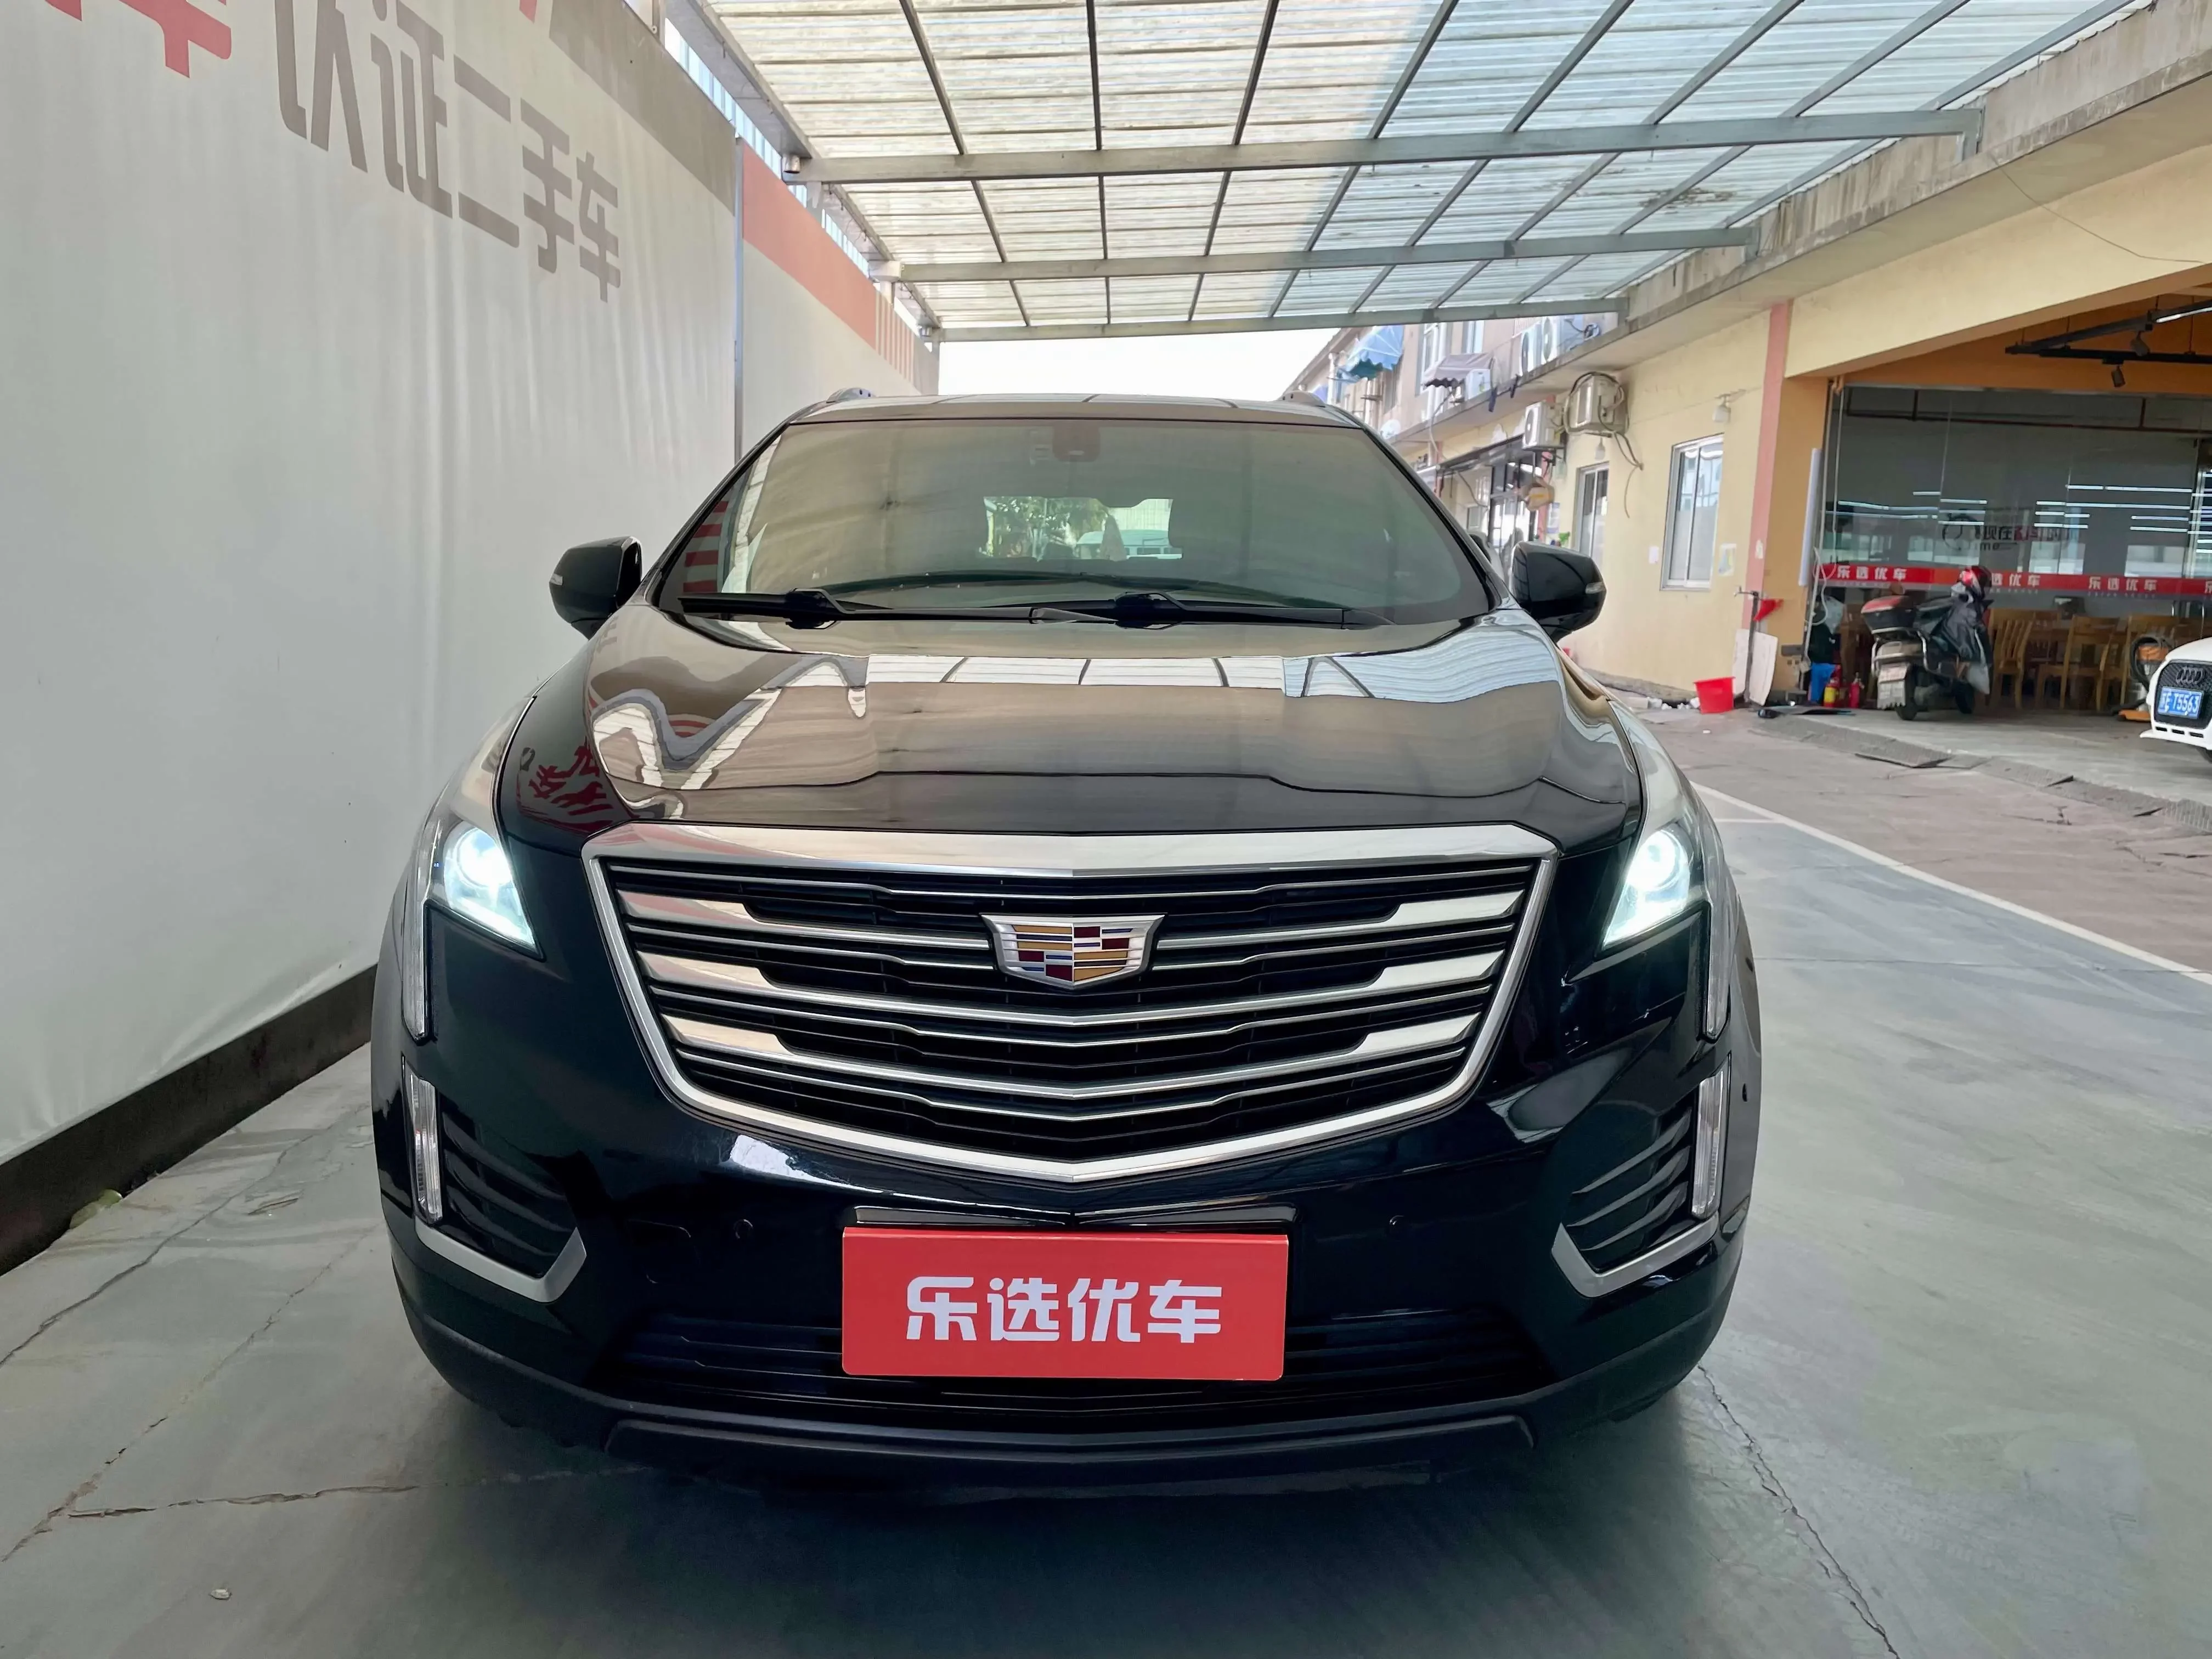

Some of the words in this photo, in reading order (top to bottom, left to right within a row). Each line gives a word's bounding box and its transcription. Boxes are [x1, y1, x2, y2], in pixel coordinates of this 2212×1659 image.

[275, 0, 620, 303] 认证二手车
[1837, 565, 1907, 581] 乐选优车
[1991, 573, 2041, 586] 选优车
[2088, 576, 2158, 591] 乐选优车
[906, 1277, 1222, 1343] 乐选优车
